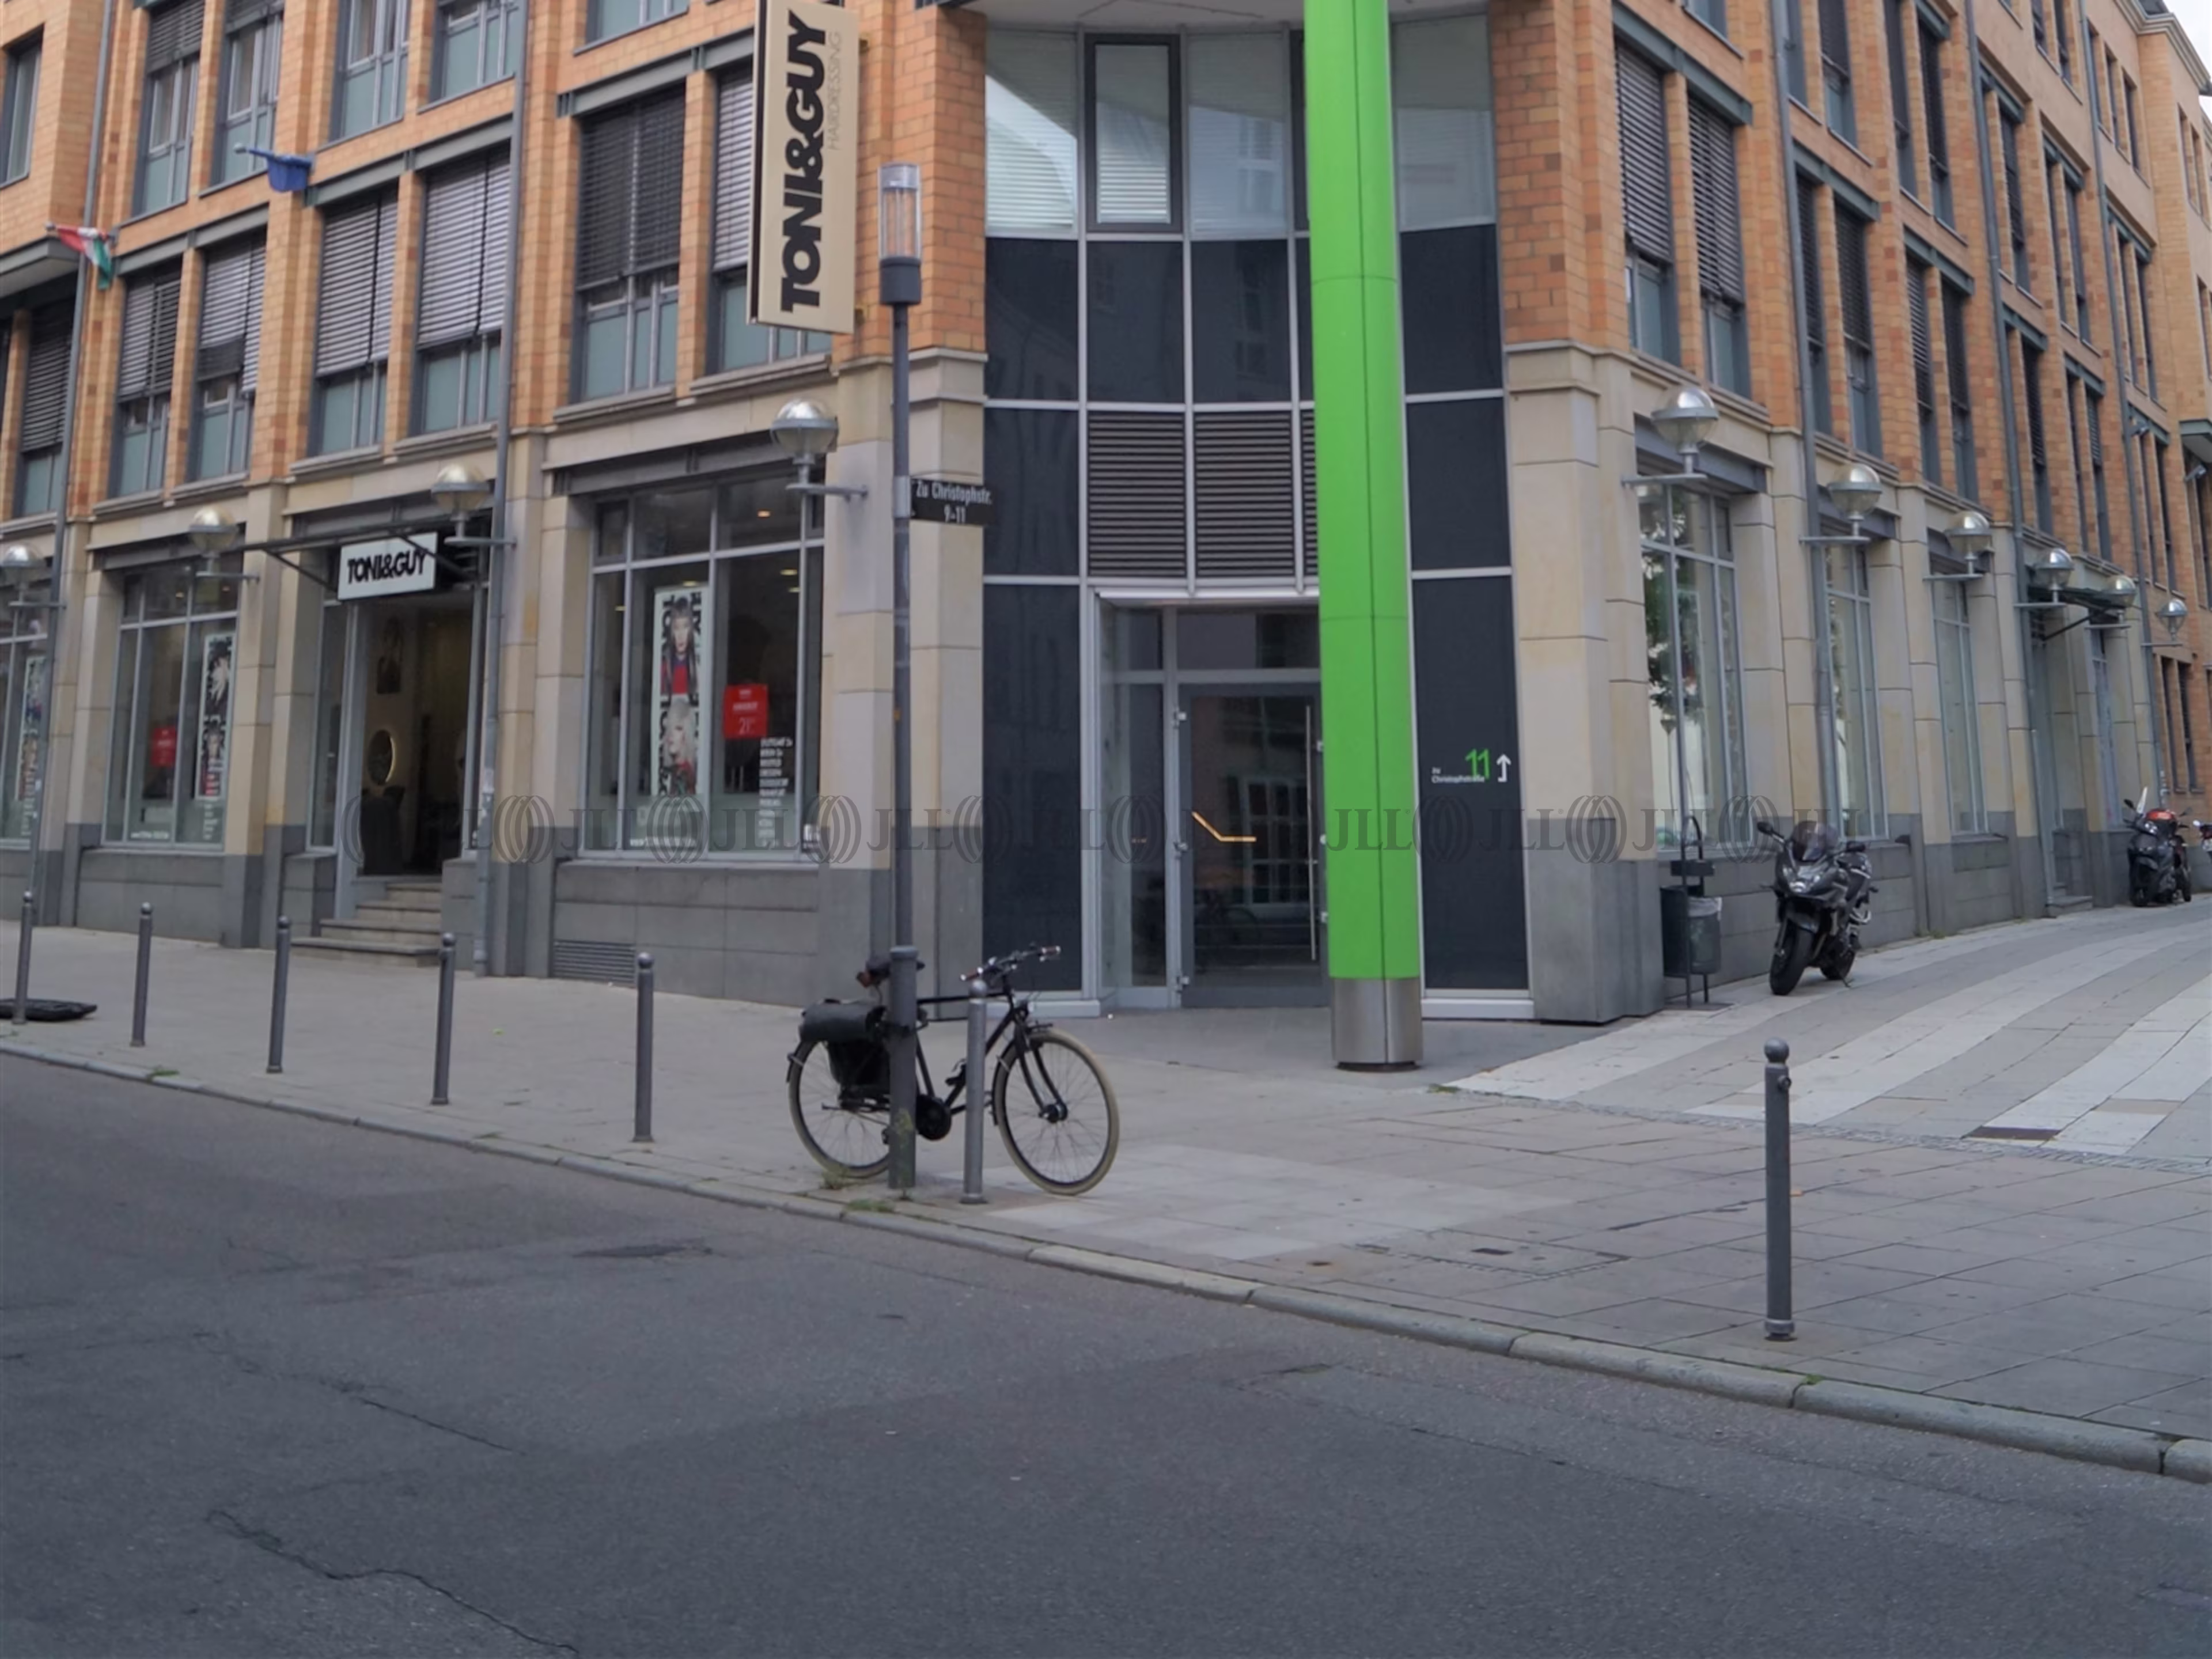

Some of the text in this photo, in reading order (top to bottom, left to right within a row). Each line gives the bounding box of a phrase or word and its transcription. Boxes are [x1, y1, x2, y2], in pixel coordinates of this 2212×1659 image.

[827, 30, 842, 151] HAIRDRESSING
[780, 8, 826, 313] TONI&GUY
[916, 480, 992, 505] Zu Christophstr.
[944, 504, 966, 524] 9-11
[347, 548, 427, 585] TONI&GUY
[1465, 748, 1491, 780] 11
